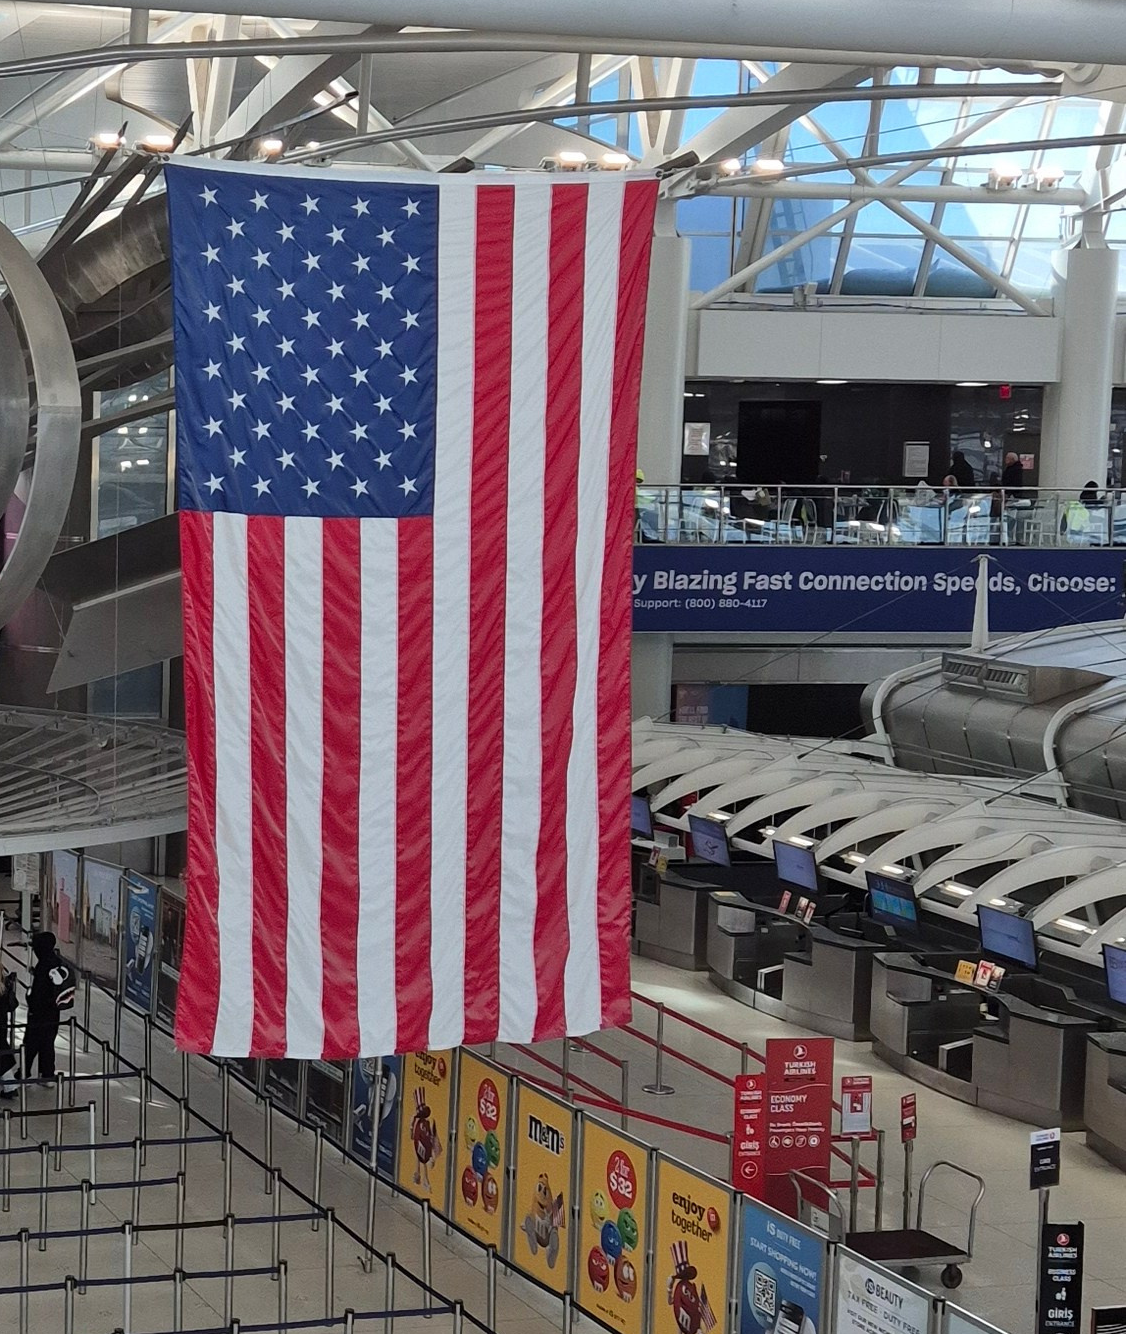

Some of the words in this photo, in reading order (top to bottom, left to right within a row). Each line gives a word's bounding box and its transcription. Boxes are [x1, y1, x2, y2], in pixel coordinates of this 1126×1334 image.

[653, 569, 738, 595] Blazing
[743, 571, 793, 591] Fast
[799, 571, 927, 592] Connection
[1028, 572, 1116, 593] Choose:
[634, 599, 681, 609] Support:
[685, 598, 716, 609] (800)
[718, 599, 768, 609] 880-4117
[770, 1094, 808, 1104] ECONOMY
[770, 1104, 794, 1113] CLASS
[609, 1173, 633, 1199] $32
[672, 1192, 706, 1222] enjoy
[671, 1209, 713, 1243] together
[847, 1290, 860, 1303] TAX
[862, 1298, 878, 1314] FREE
[883, 1311, 901, 1327] DUTY
[876, 1284, 904, 1309] BEAUTY
[1048, 1307, 1074, 1320] GİRİŞ
